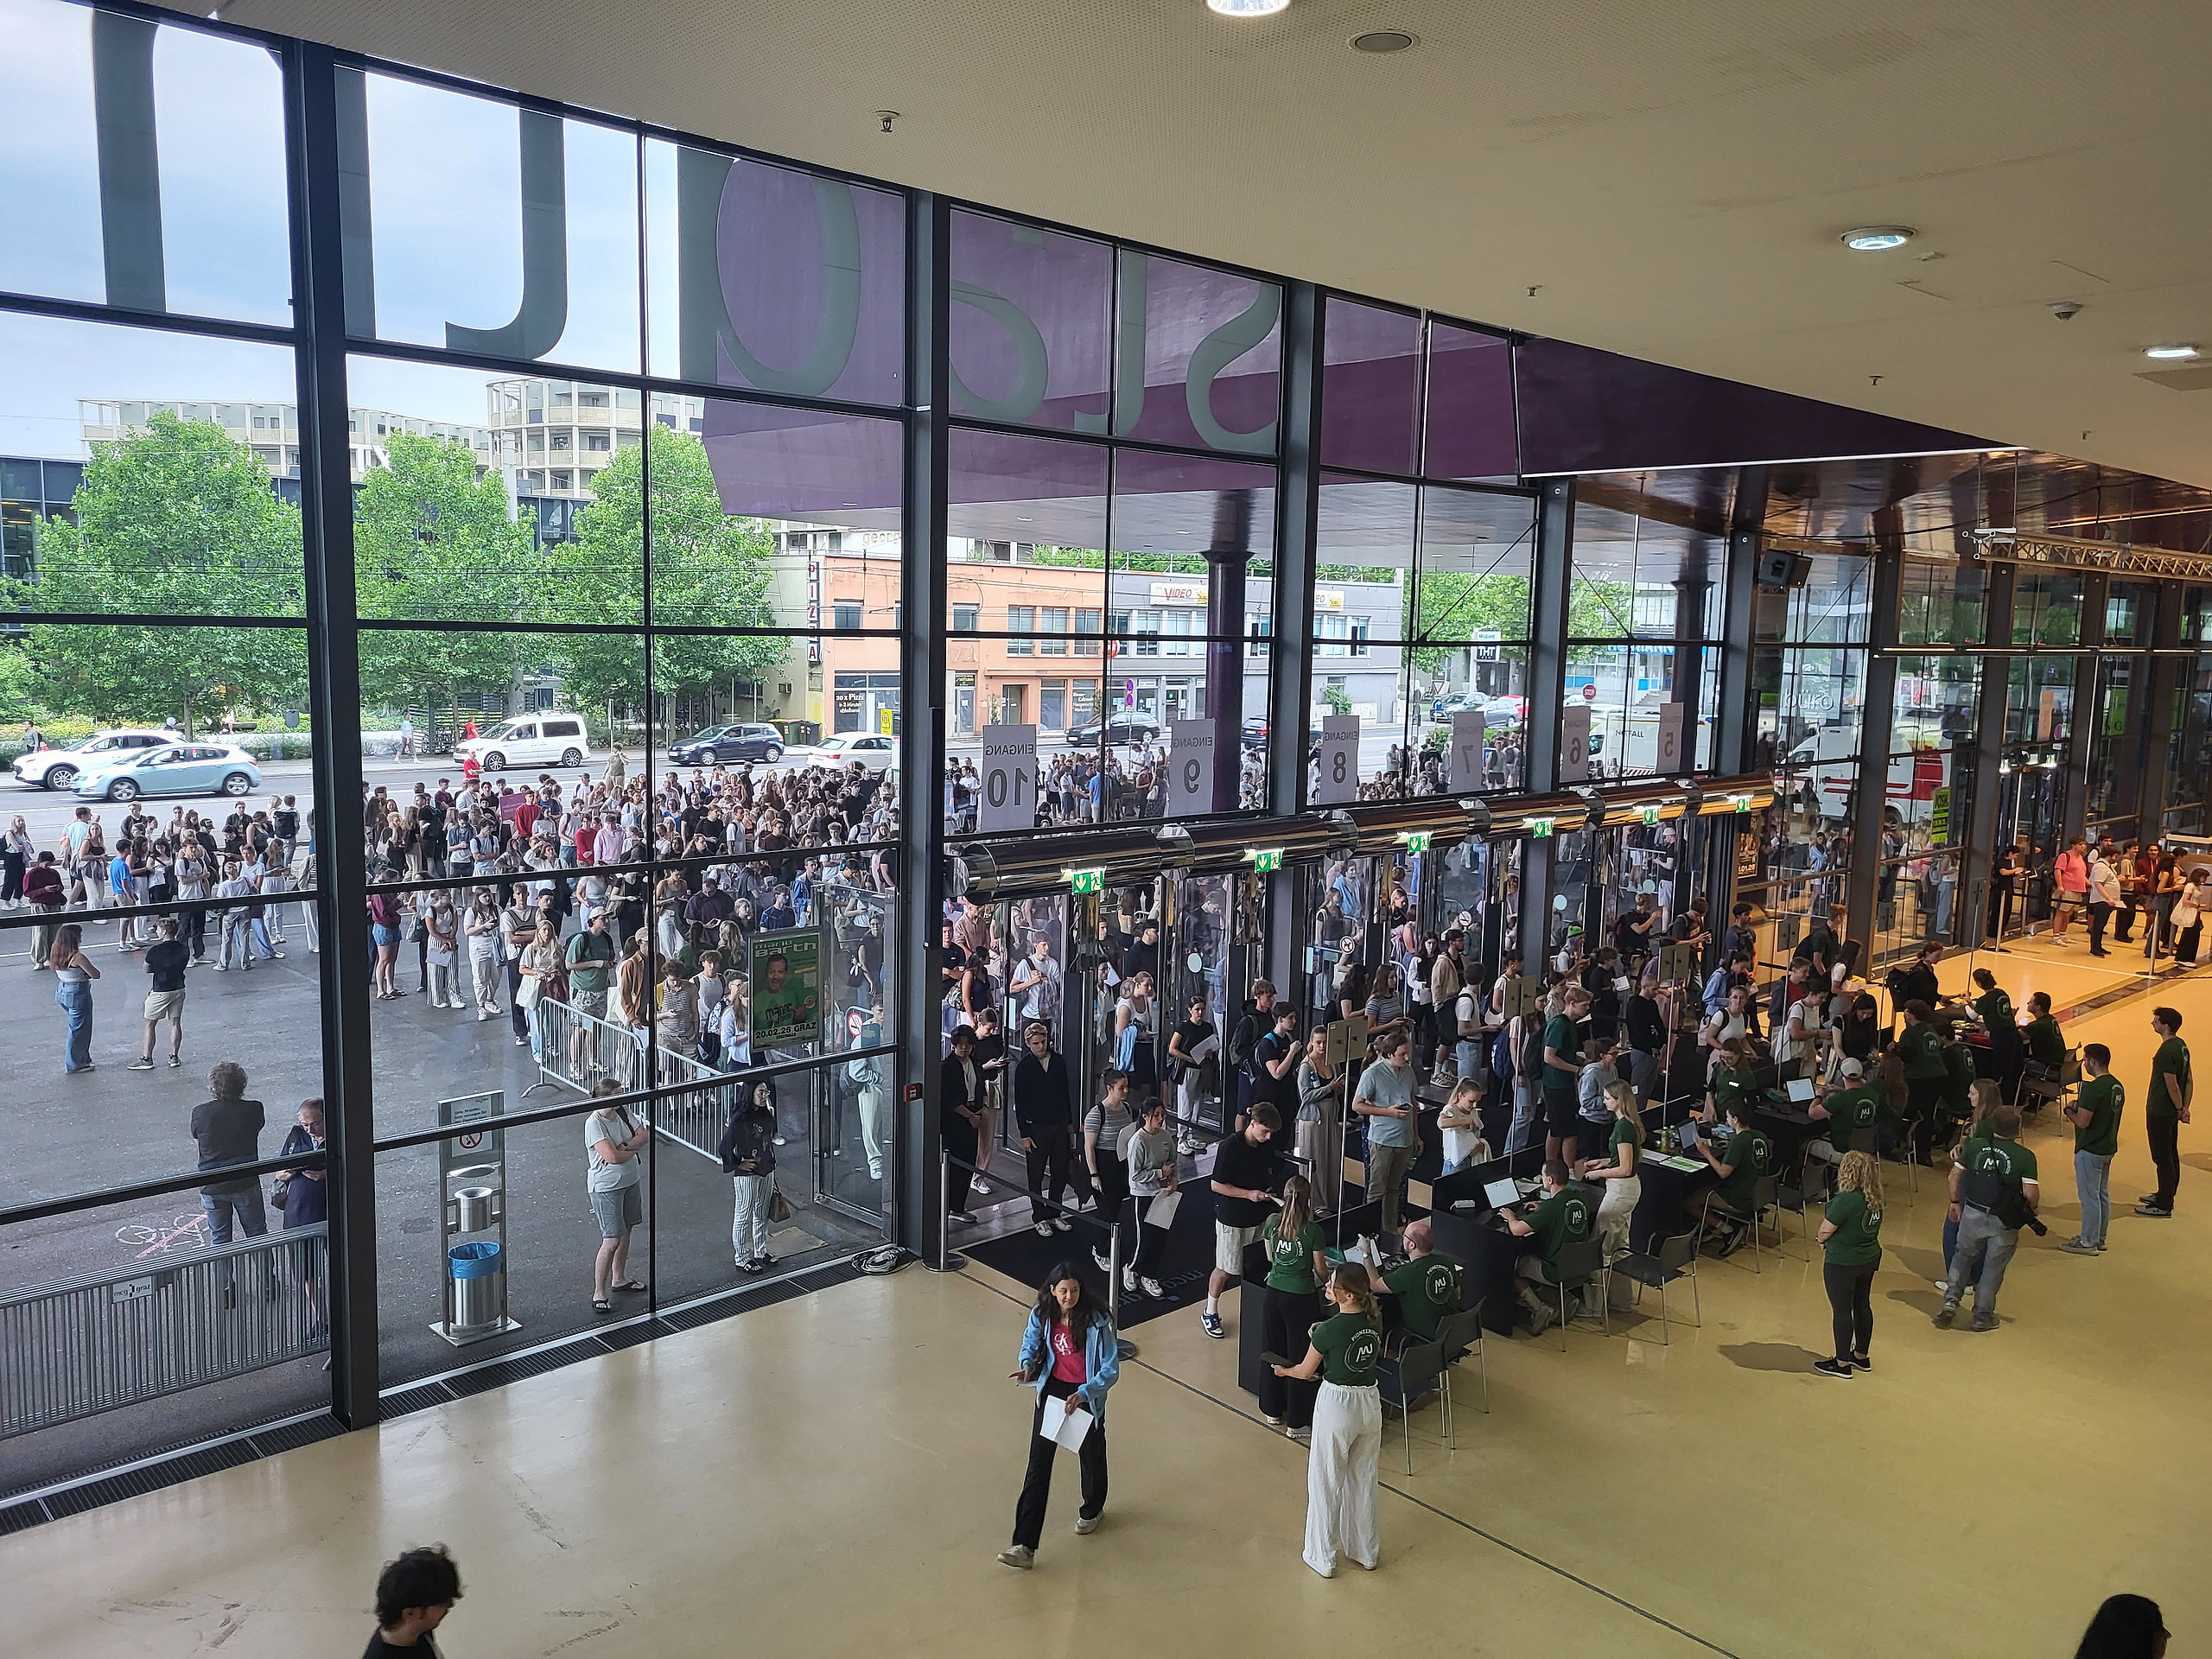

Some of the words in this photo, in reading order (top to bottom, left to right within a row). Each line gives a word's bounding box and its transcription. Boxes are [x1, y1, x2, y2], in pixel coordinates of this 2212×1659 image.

[1164, 588, 1192, 601] VIDEO
[1478, 646, 1495, 656] THT
[756, 1026, 791, 1039] 20.02.26
[794, 1022, 817, 1032] GRAZ
[136, 1284, 151, 1293] graz
